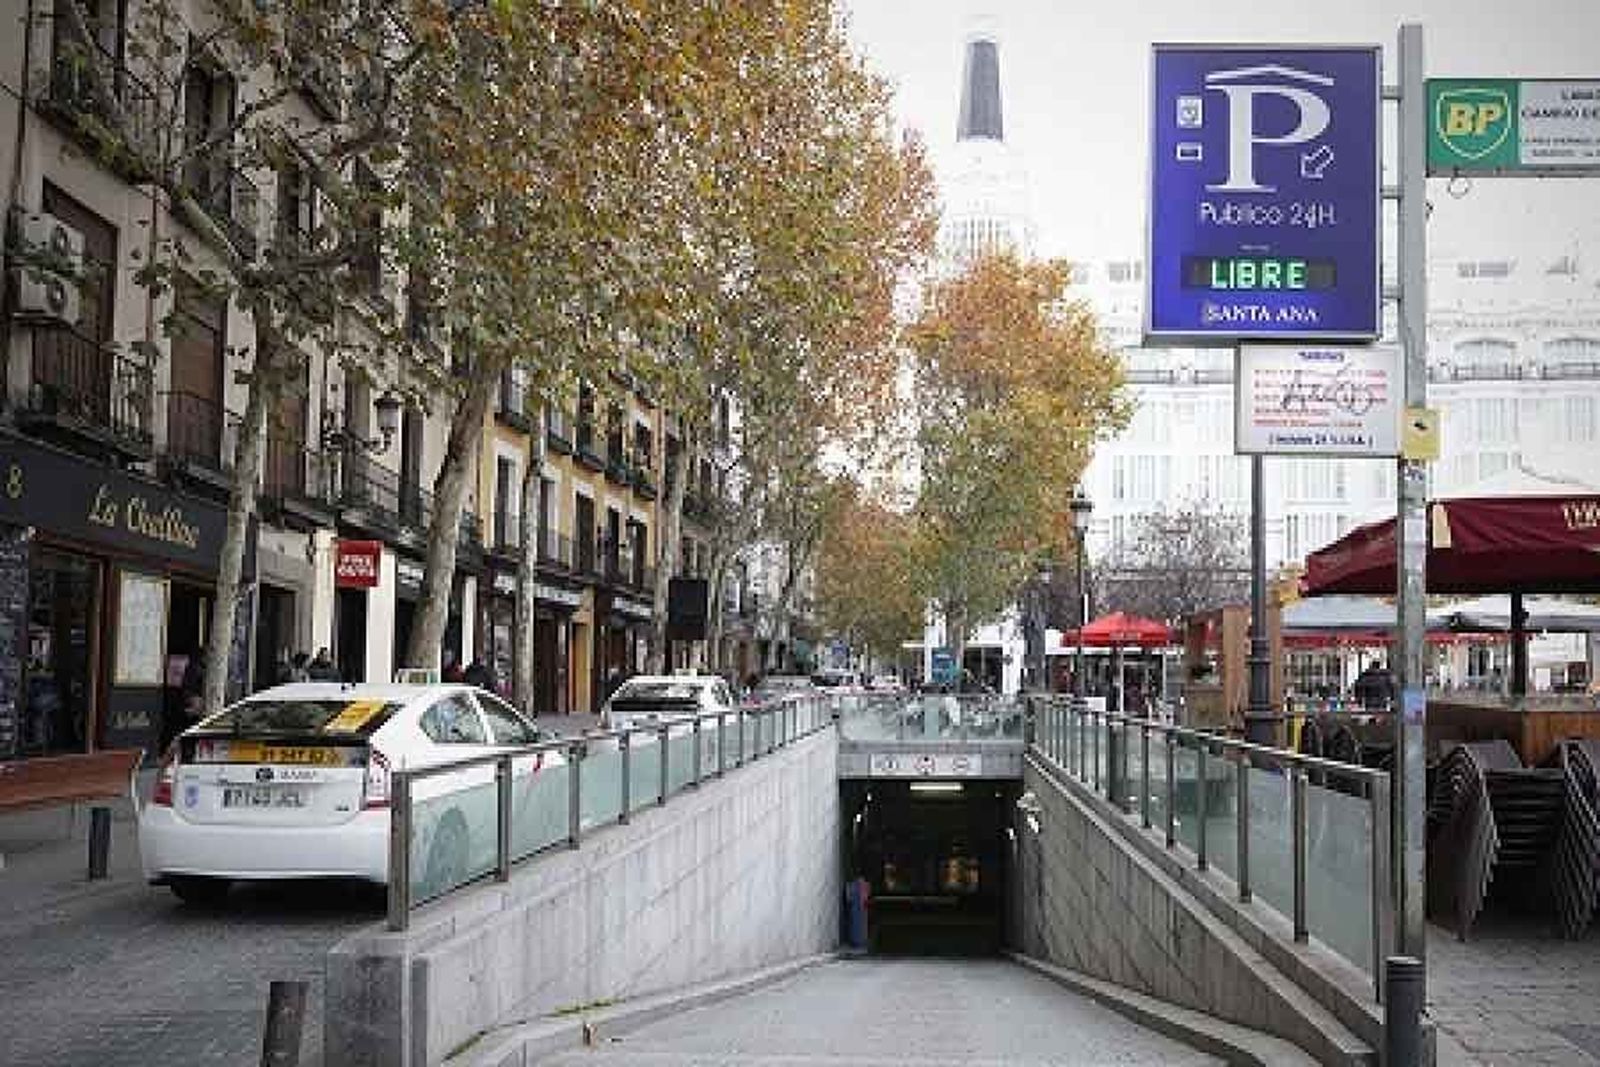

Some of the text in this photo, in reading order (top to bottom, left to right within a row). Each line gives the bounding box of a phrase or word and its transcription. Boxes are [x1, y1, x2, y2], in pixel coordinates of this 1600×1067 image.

[1446, 102, 1505, 136] BP
[1205, 84, 1331, 193] P
[1290, 202, 1337, 228] 24H
[1211, 259, 1307, 289] LIBRE
[1206, 304, 1320, 322] SANTA ANA
[7, 465, 23, 499] 8
